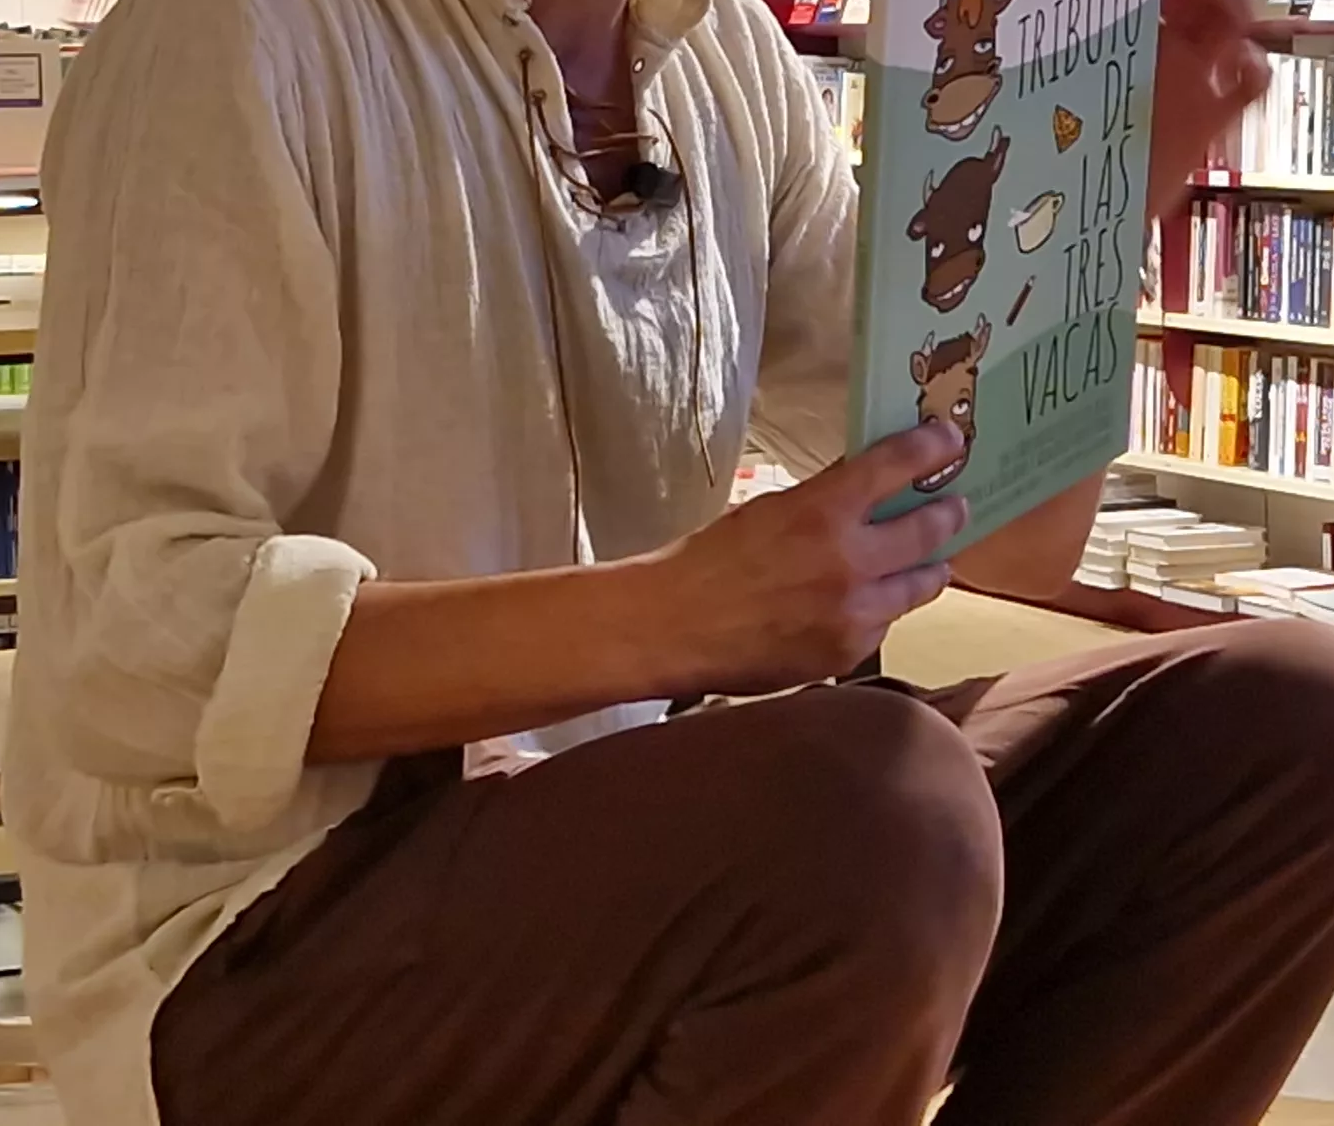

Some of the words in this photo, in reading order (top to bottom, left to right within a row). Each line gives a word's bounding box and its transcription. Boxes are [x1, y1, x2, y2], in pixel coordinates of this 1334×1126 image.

[1102, 50, 1137, 141] DE
[1079, 134, 1131, 235] LAS
[1063, 218, 1125, 323] TRES
[1023, 302, 1119, 424] VACAS
